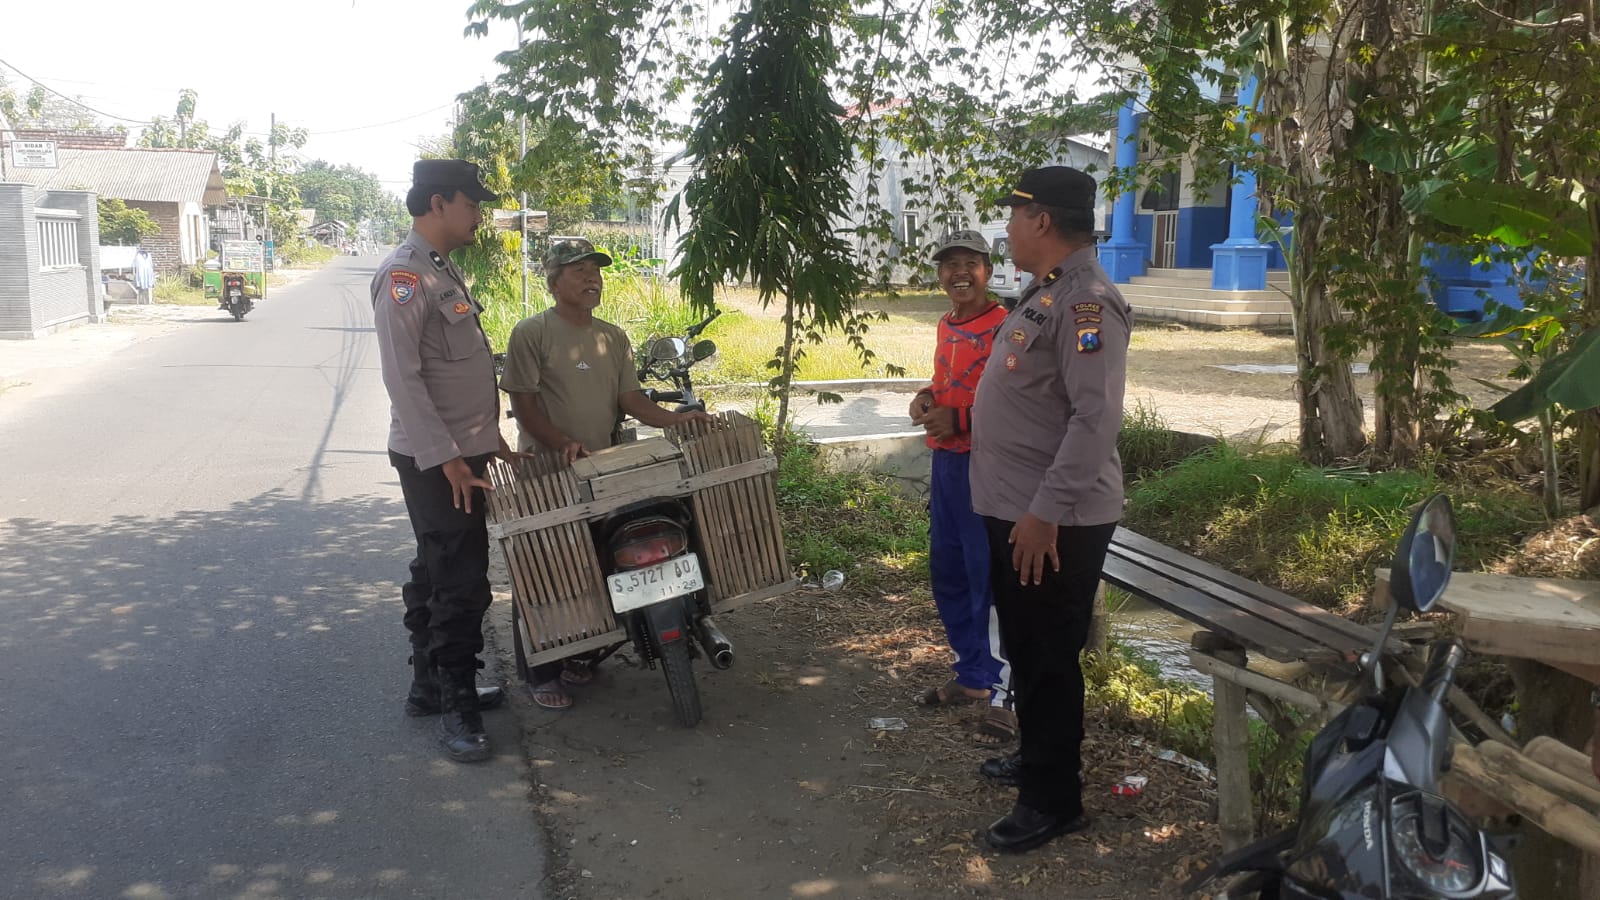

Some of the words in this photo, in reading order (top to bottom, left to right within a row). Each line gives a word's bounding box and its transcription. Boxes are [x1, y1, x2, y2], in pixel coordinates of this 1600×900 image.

[1022, 307, 1047, 326] POLRI
[614, 579, 623, 593] S
[630, 566, 664, 587] 5727
[1363, 800, 1373, 850] HONDA
